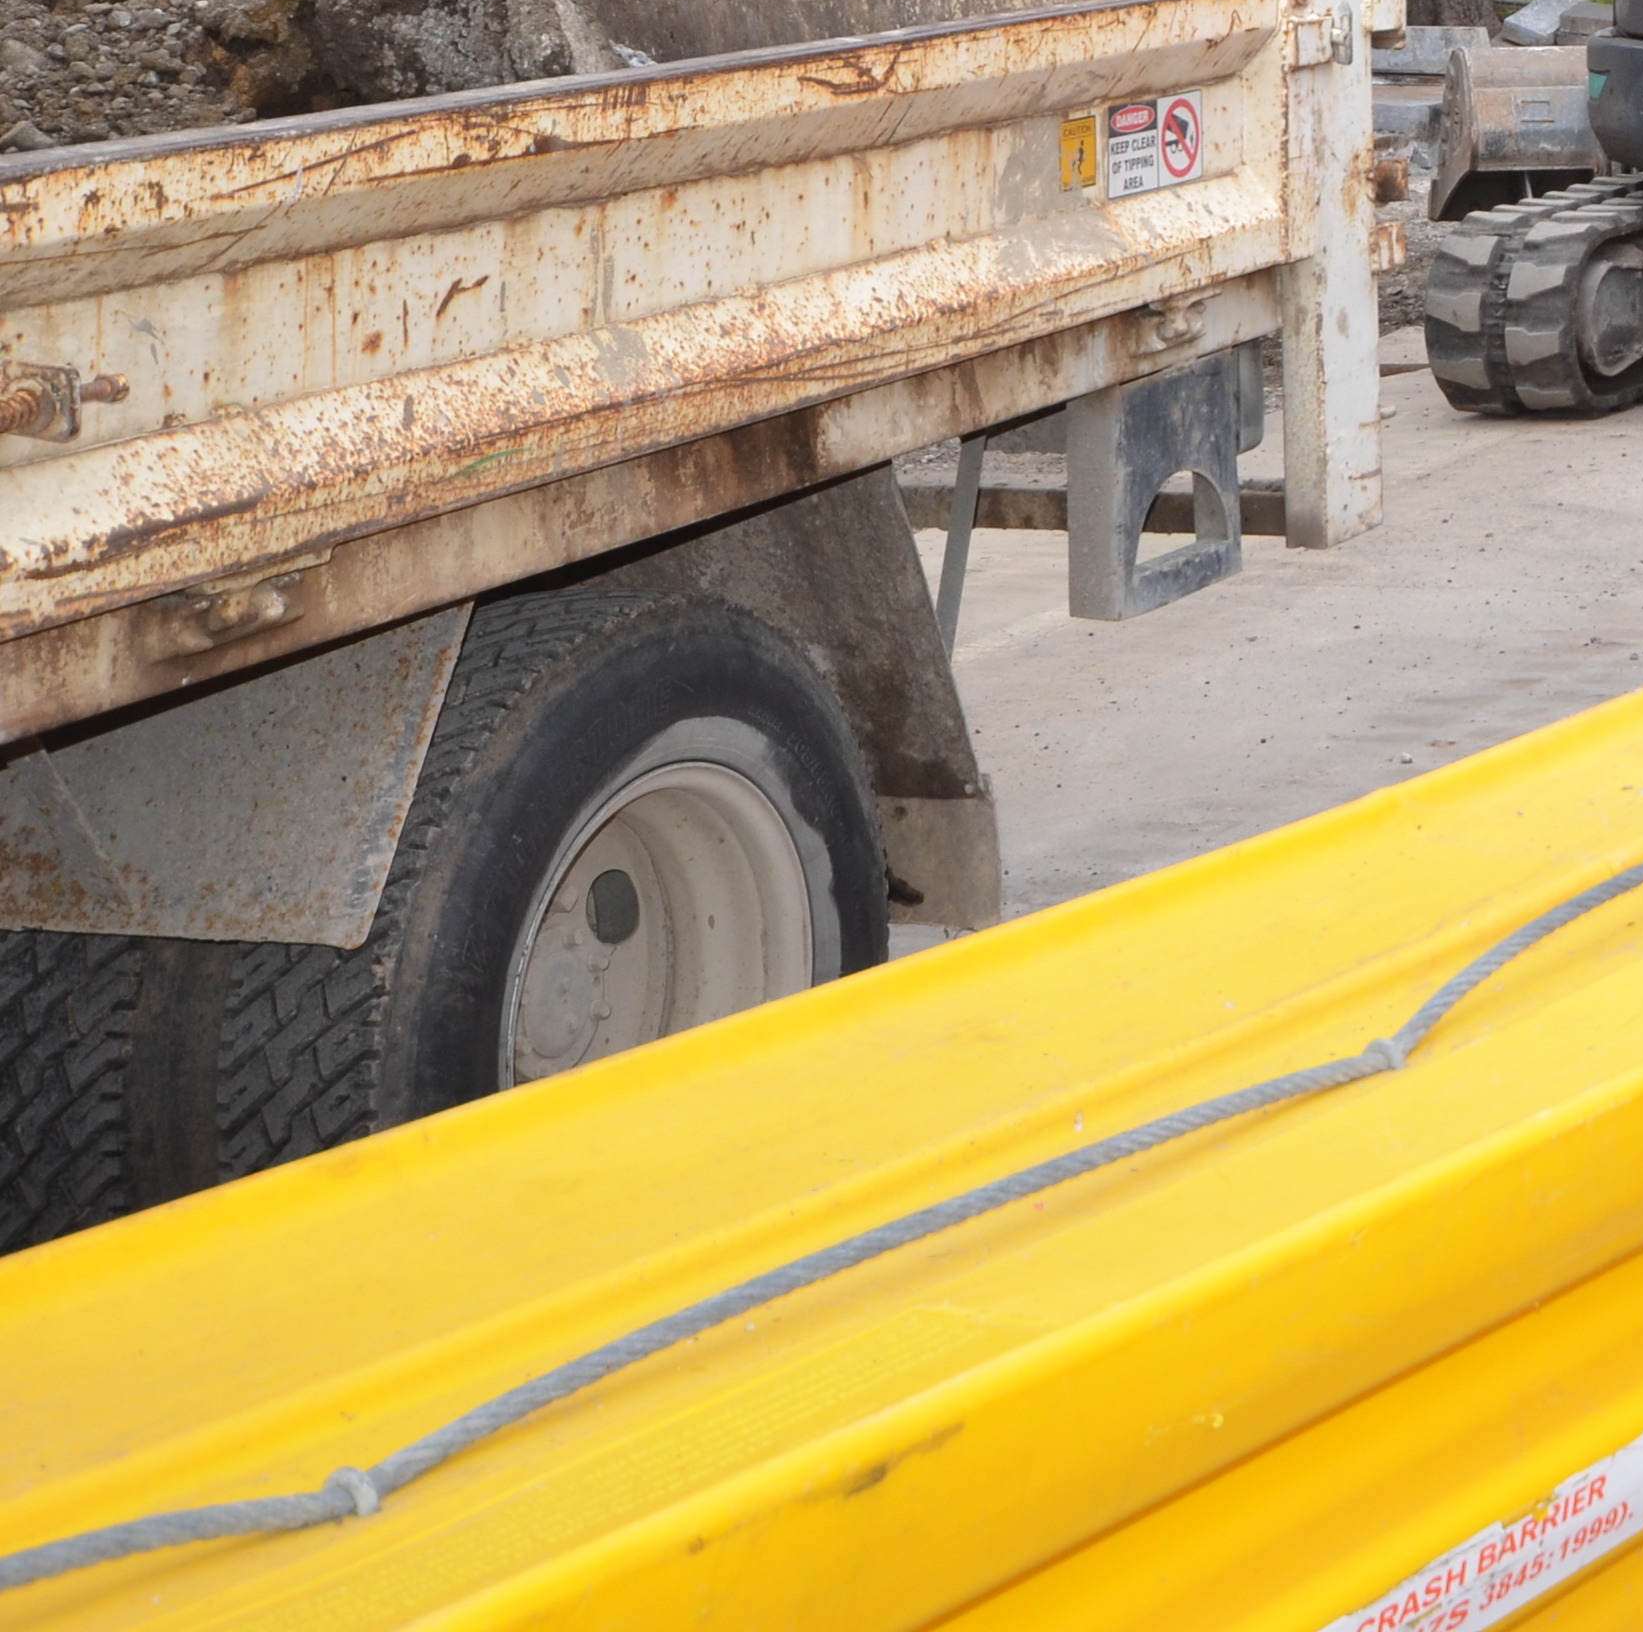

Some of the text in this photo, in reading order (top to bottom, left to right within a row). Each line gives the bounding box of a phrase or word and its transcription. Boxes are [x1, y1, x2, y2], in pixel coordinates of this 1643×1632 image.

[1116, 110, 1149, 128] DANGER
[1063, 124, 1091, 137] CAUTION
[1110, 135, 1156, 156] KEEP CLEAR
[1112, 154, 1154, 175] OF TIPPING
[1123, 176, 1144, 191] AREA
[1477, 1474, 1607, 1574] BARRIER
